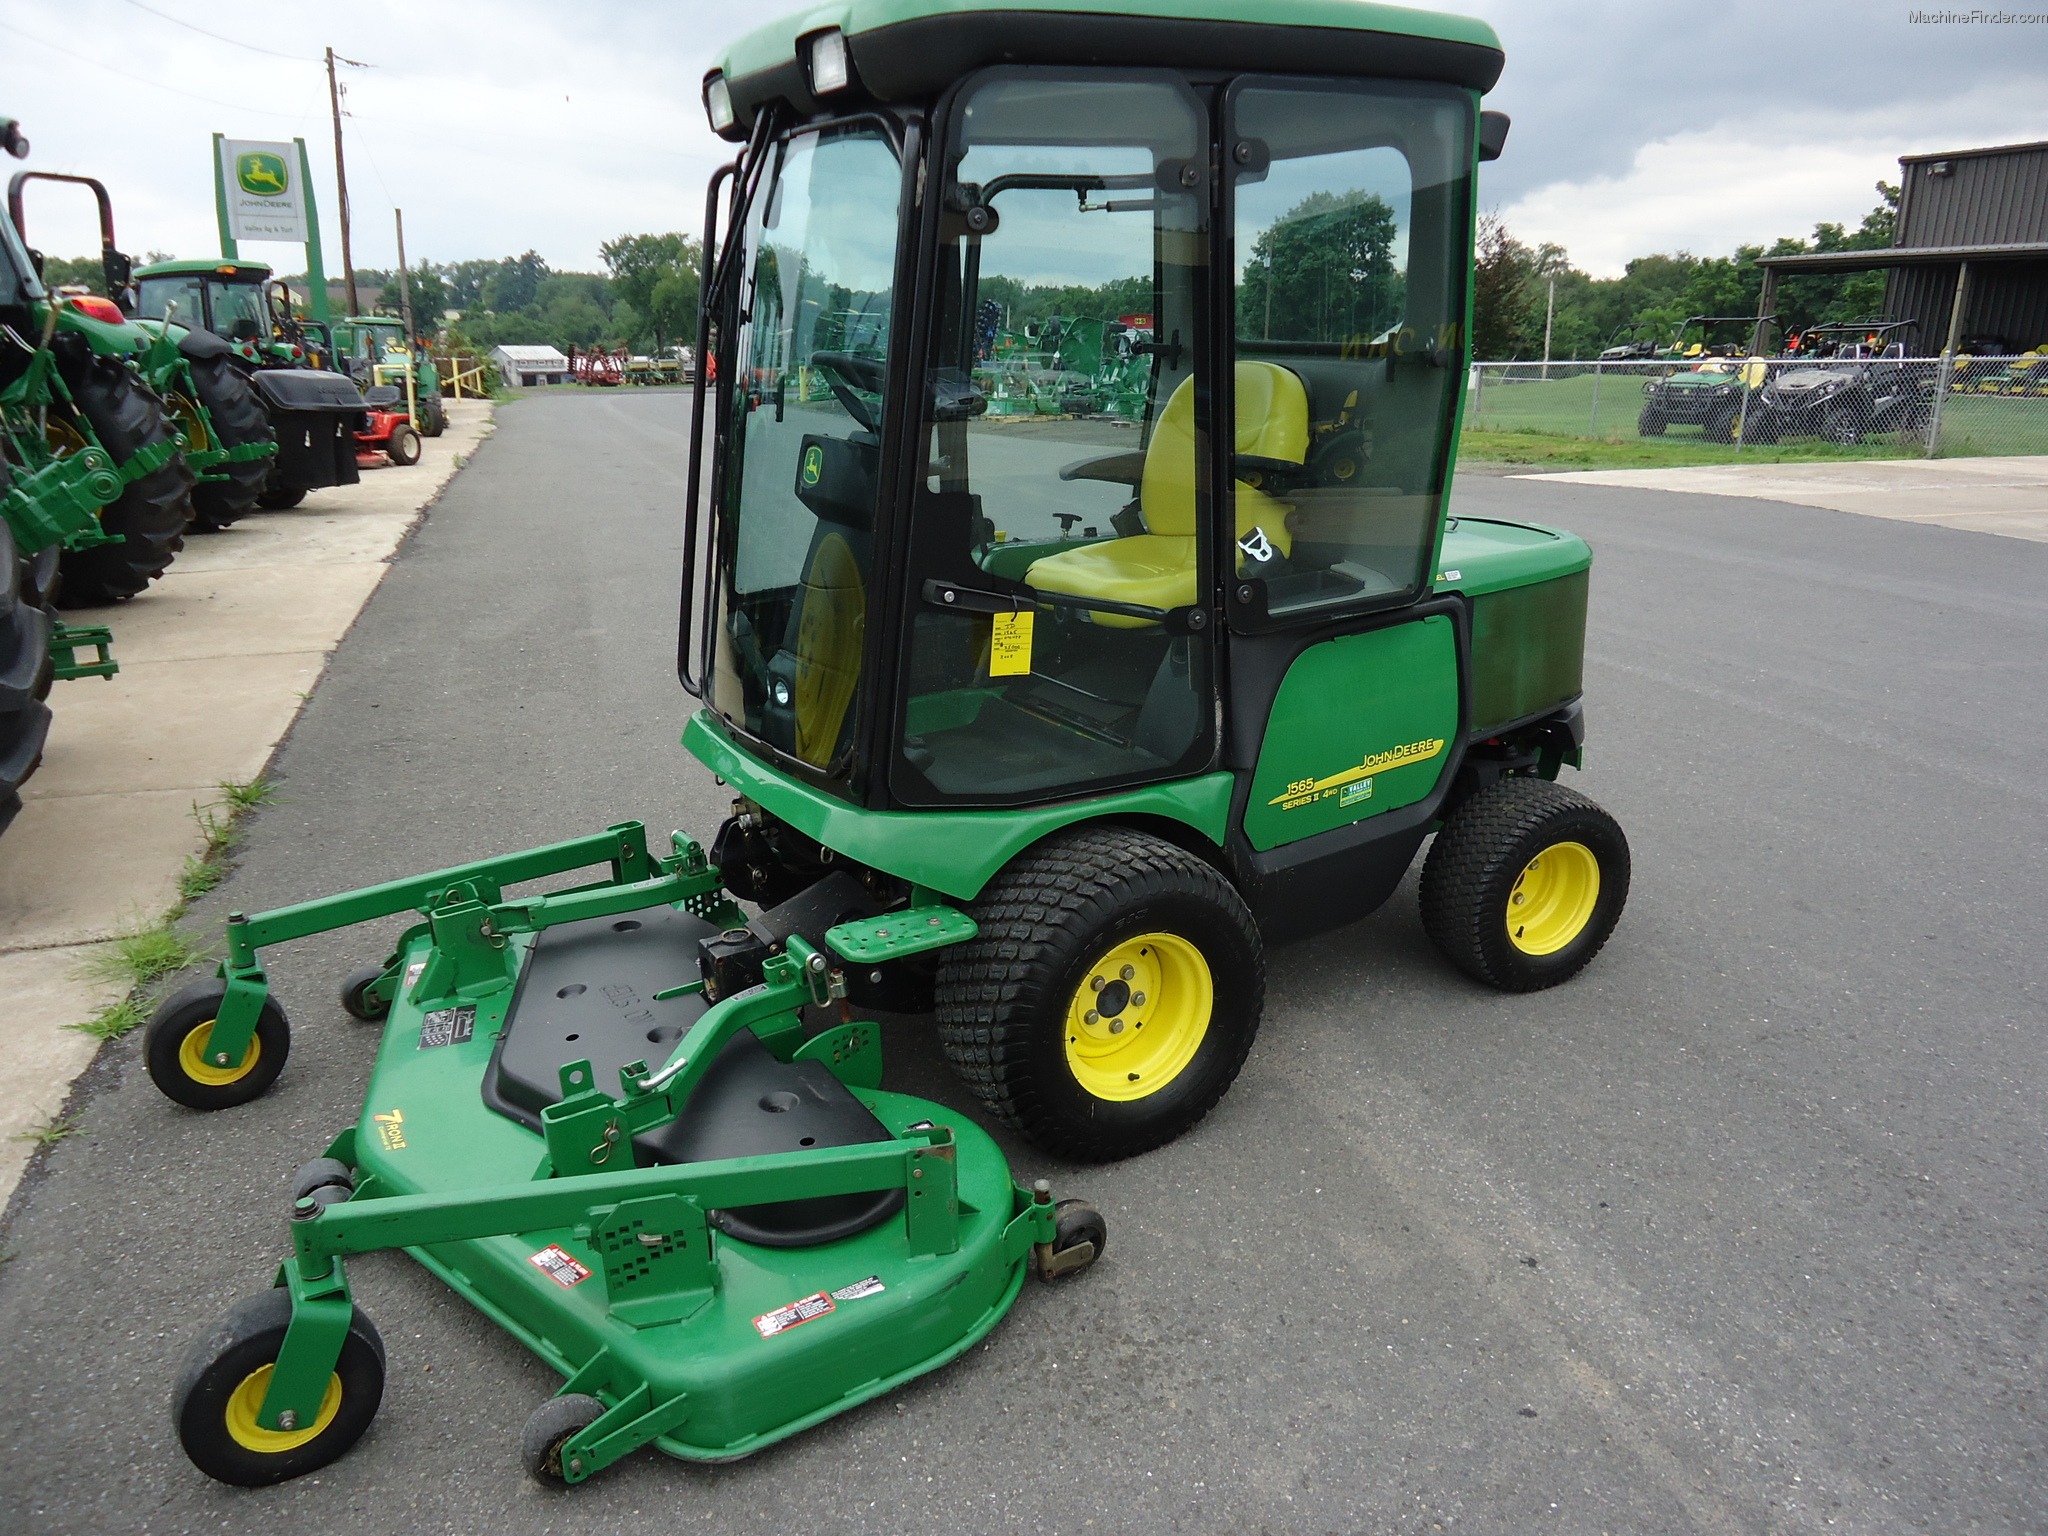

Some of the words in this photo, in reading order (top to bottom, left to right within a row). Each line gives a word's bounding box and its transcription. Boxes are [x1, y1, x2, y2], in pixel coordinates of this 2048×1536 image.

[1359, 749, 1394, 770] JOHN
[1394, 738, 1435, 760] DEERE
[1286, 777, 1315, 796] 1565
[1282, 796, 1312, 811] SERIES
[1322, 788, 1338, 799] 4WD
[374, 1109, 404, 1123] 7
[385, 1121, 404, 1143] IRON
